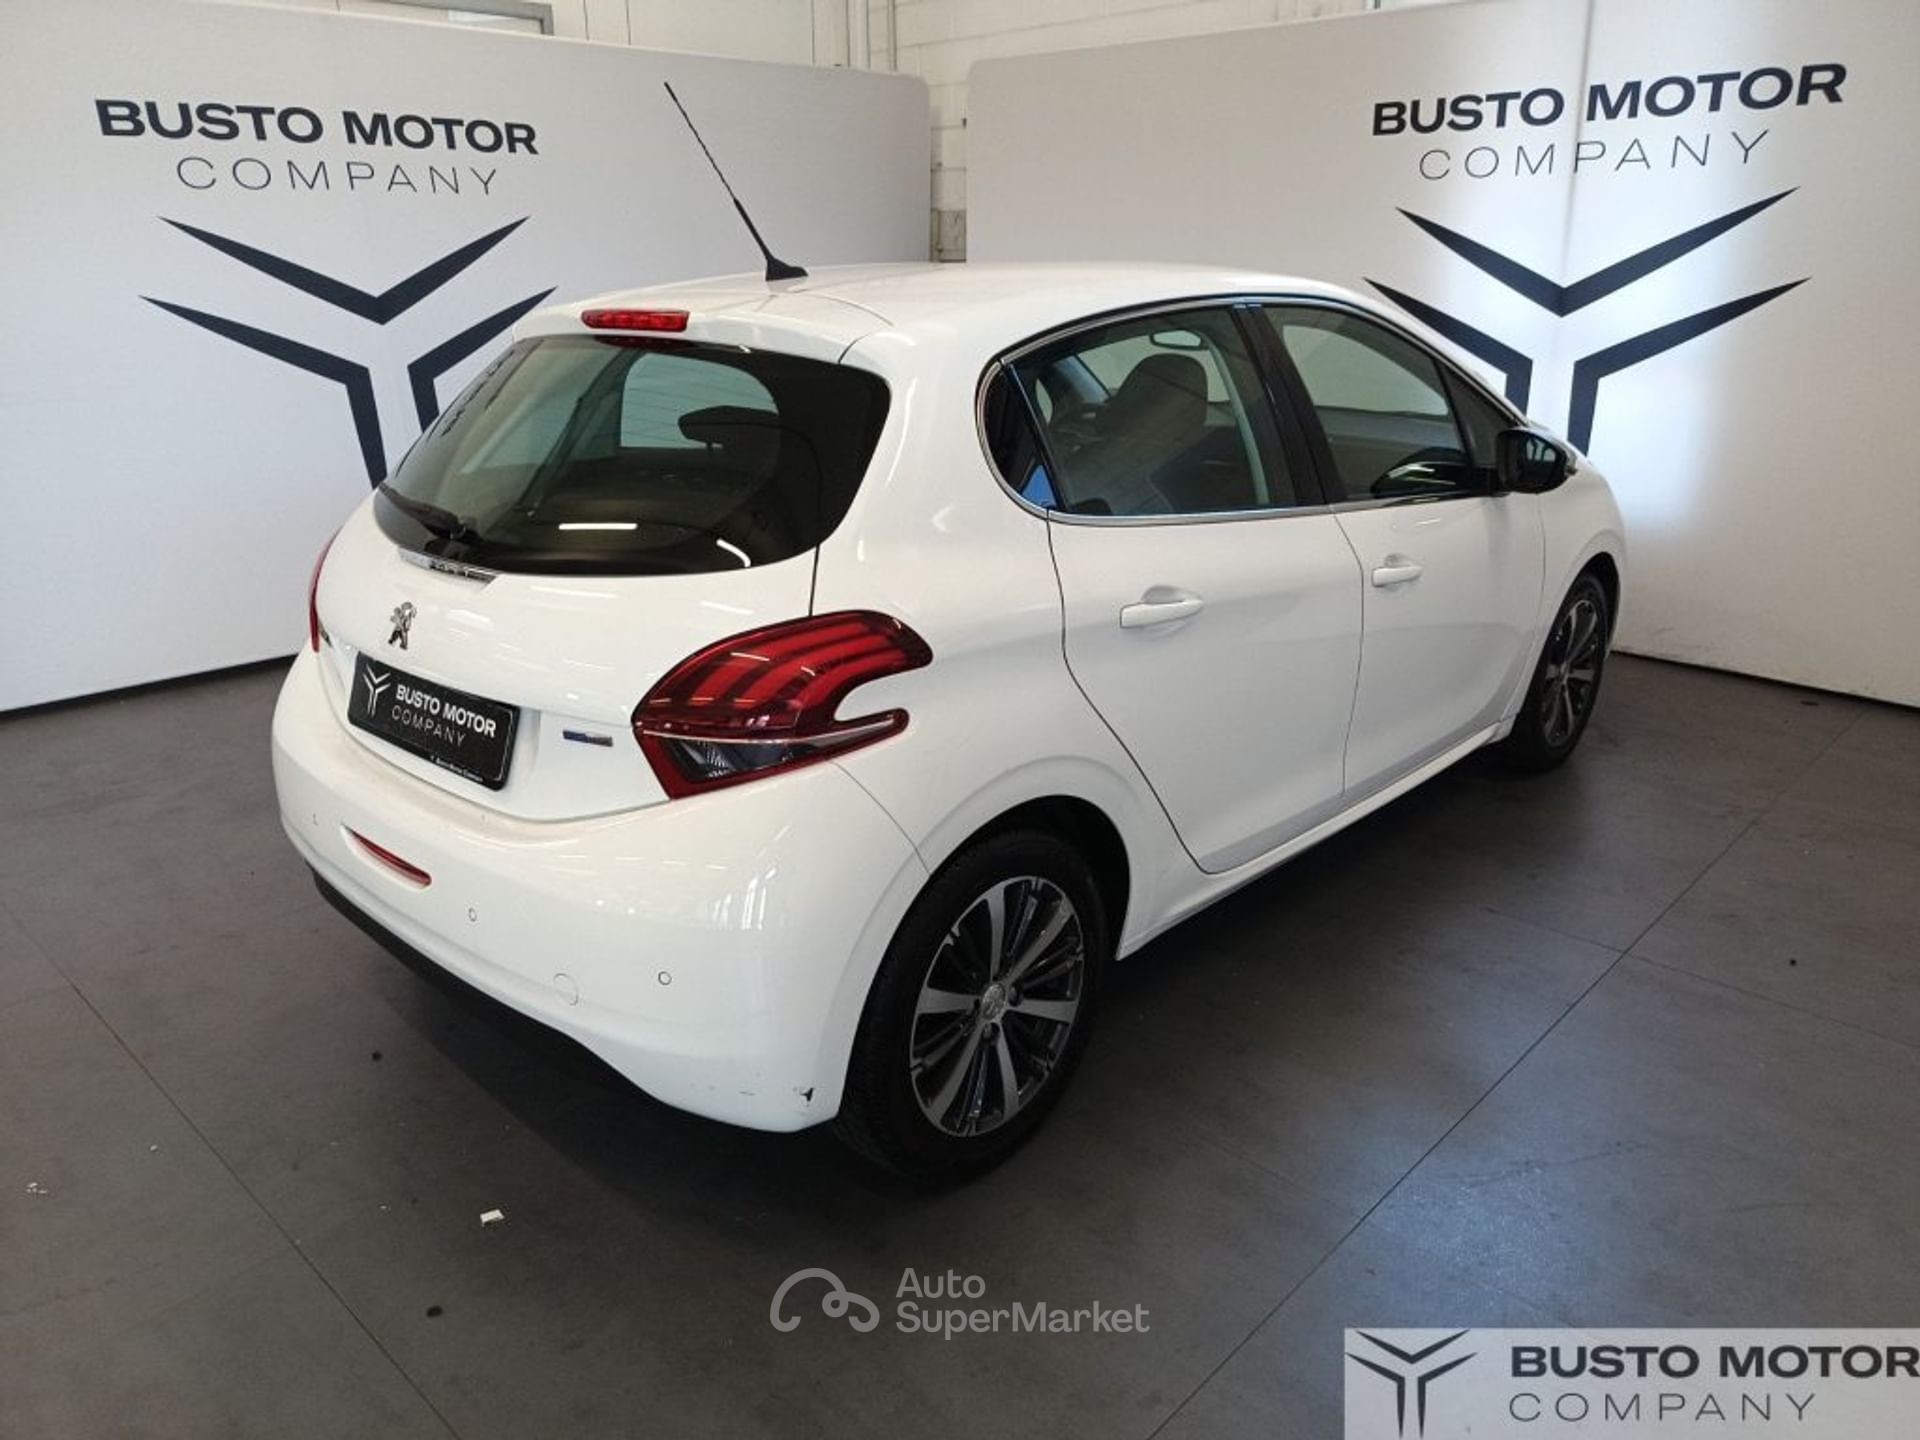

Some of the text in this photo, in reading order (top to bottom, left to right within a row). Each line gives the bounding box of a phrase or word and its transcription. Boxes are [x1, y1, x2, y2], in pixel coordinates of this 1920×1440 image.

[1372, 62, 1847, 136] BUSTO MOTOR
[95, 98, 539, 156] BUSTO MOTOR
[176, 157, 498, 196] COMPANY
[1419, 129, 1770, 180] COMPANY
[392, 705, 466, 747] COMPANY
[395, 684, 497, 739] BUSTO MOTOR
